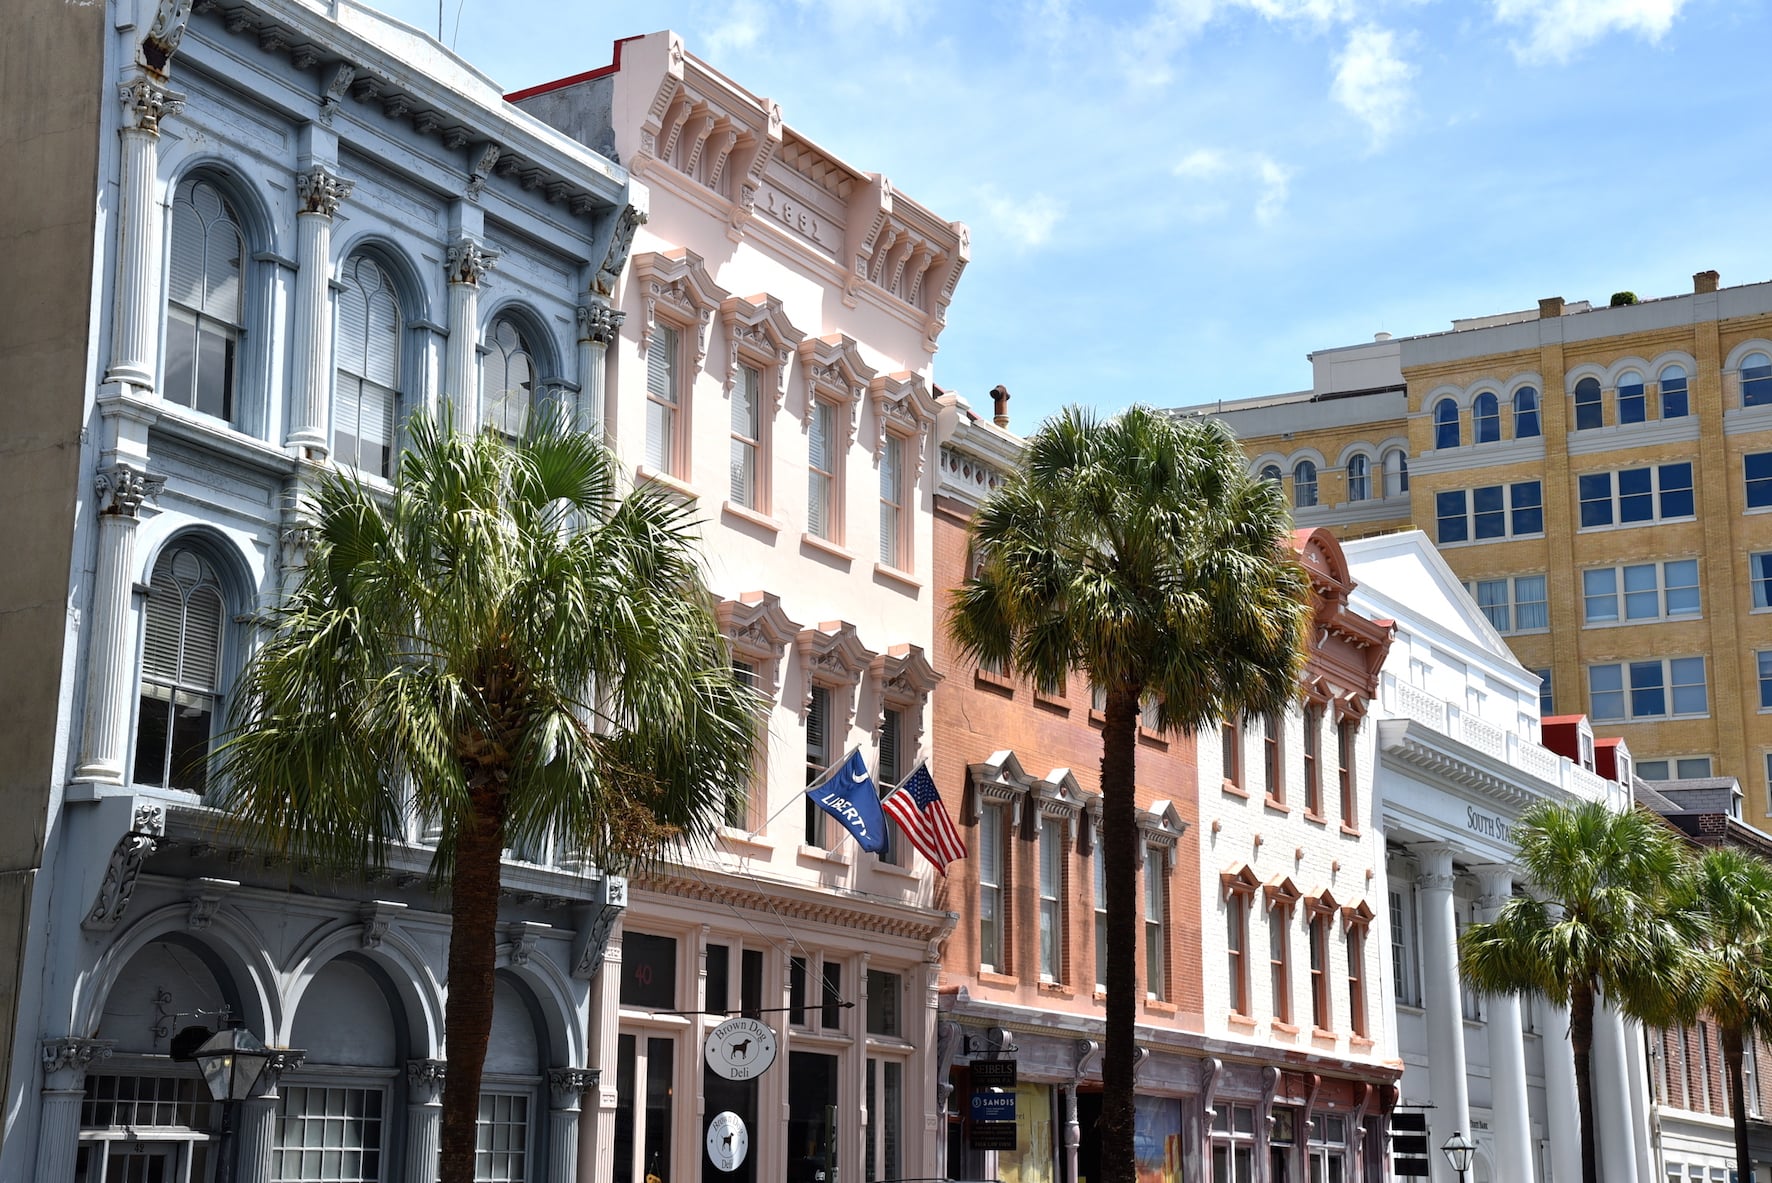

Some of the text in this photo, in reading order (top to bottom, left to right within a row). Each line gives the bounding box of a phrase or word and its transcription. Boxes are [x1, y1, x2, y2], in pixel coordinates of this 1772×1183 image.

[821, 793, 872, 840] LIBERTY
[1467, 805, 1514, 844] SOUTH STA
[715, 1021, 767, 1042] Brown Dog
[730, 1067, 749, 1078] Deli
[983, 1098, 1015, 1106] SANDIS
